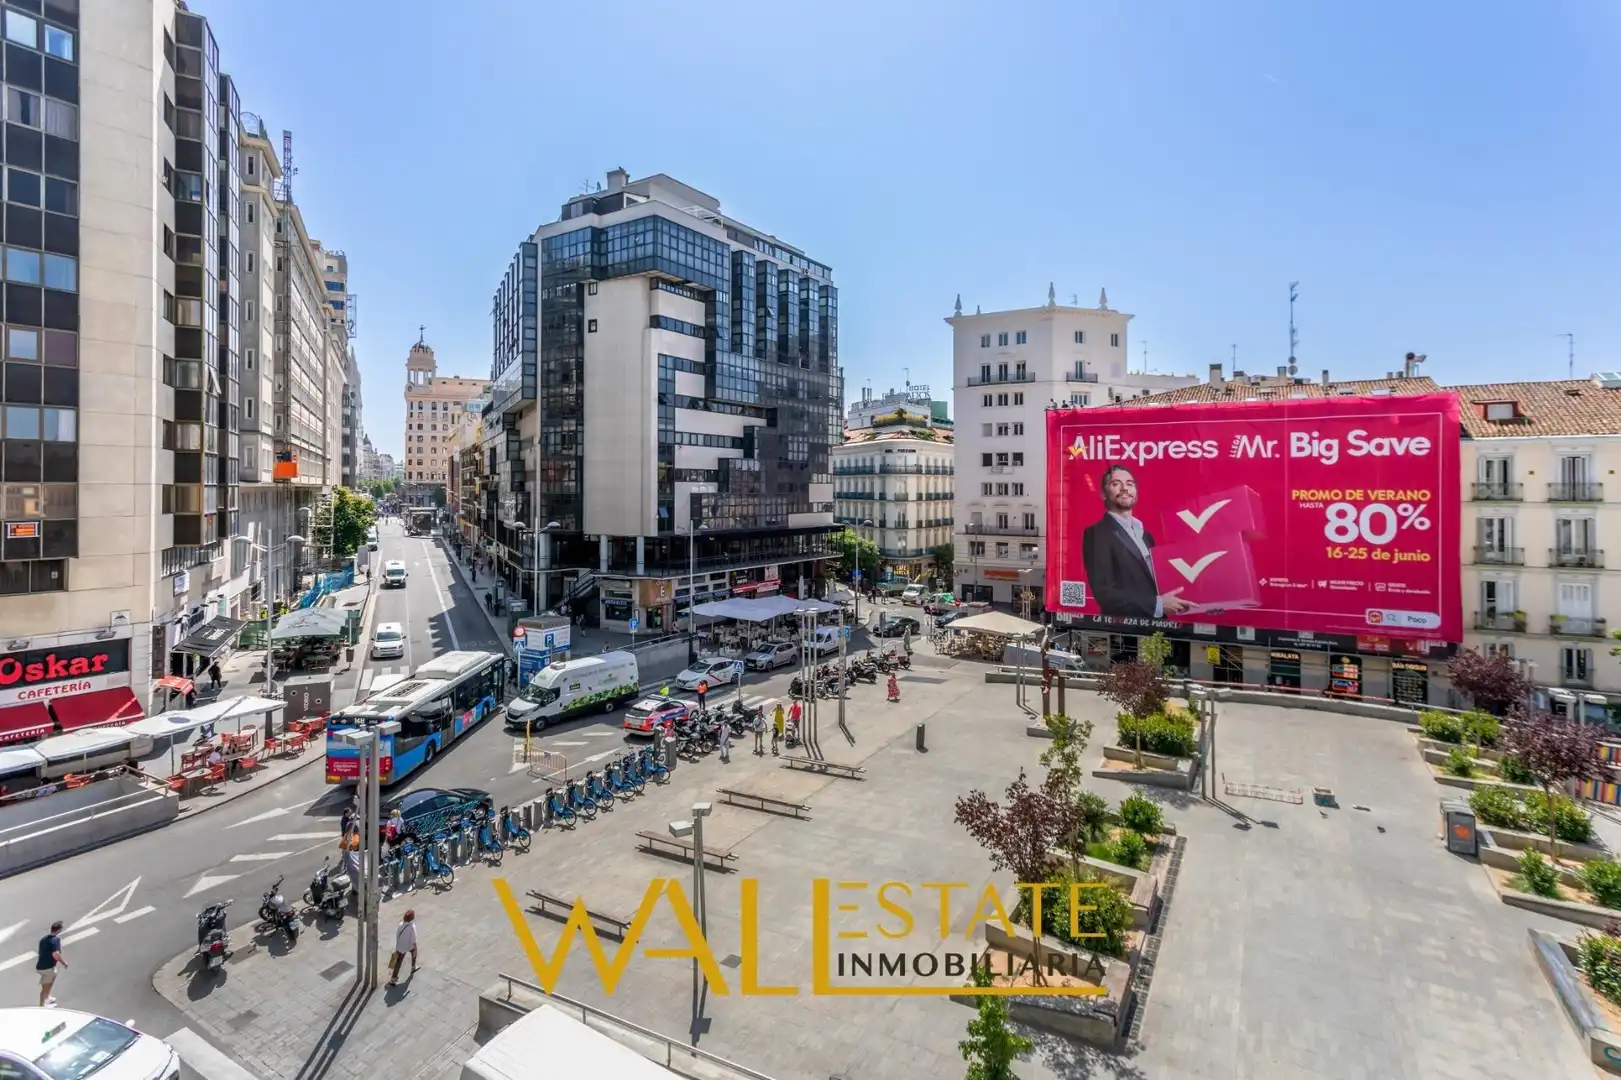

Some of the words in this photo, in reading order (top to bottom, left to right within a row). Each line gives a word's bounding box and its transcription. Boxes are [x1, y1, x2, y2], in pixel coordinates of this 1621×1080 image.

[1068, 433, 1219, 466] AliExpress
[1237, 435, 1280, 458] Mr.
[1290, 431, 1339, 465] Big
[1347, 429, 1431, 457] Save
[1291, 489, 1343, 501] PROMO
[1345, 489, 1365, 501] DE
[1367, 489, 1431, 502] VERANO
[1299, 501, 1325, 509] HASTA
[1324, 502, 1431, 545] 80%
[1326, 546, 1368, 560] 16-25
[1371, 548, 1391, 561] de
[1392, 548, 1431, 564] junio
[1140, 619, 1149, 627] DE
[0, 654, 109, 685] Oskar
[18, 681, 92, 700] CAFETERÍA
